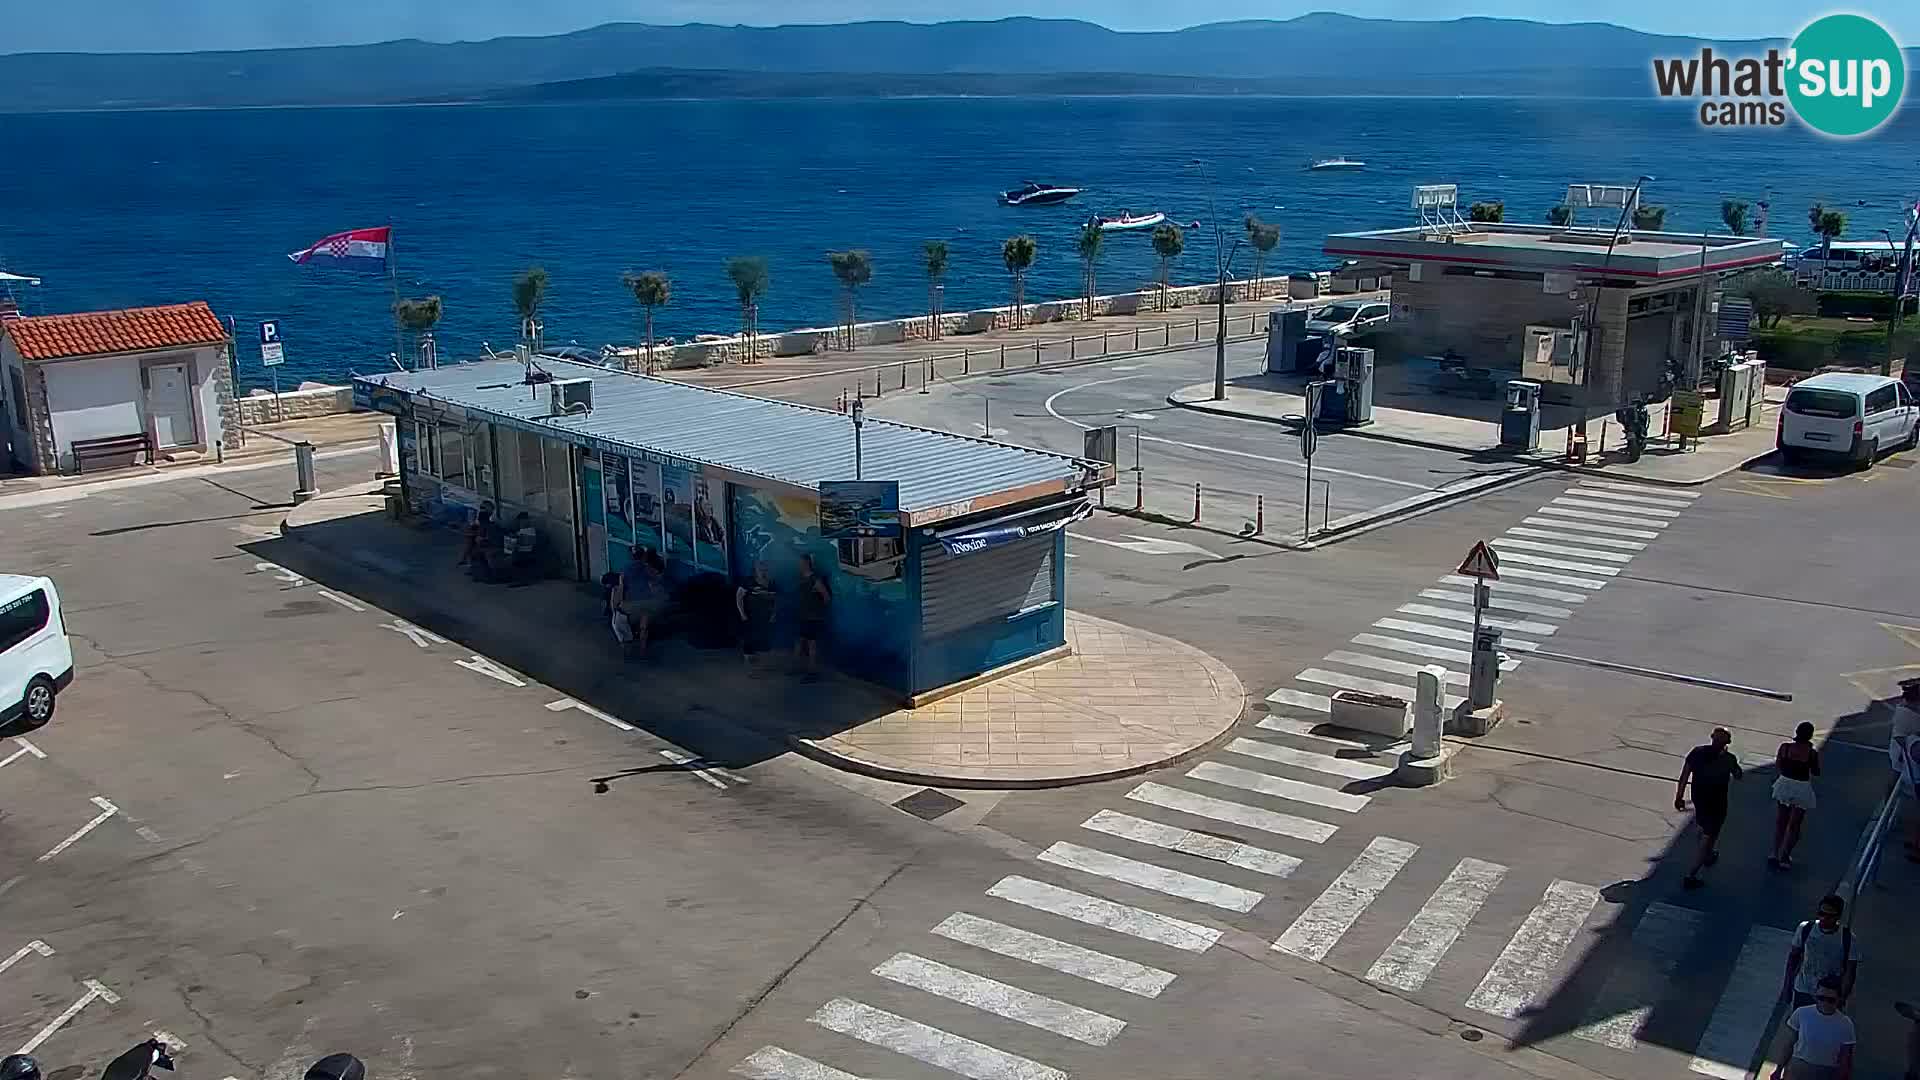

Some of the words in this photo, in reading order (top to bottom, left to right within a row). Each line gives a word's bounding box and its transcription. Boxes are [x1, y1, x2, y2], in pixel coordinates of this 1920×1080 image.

[264, 324, 275, 341] P
[613, 444, 643, 459] STATION
[644, 451, 670, 465] TICKET
[671, 458, 699, 472] OFFICE
